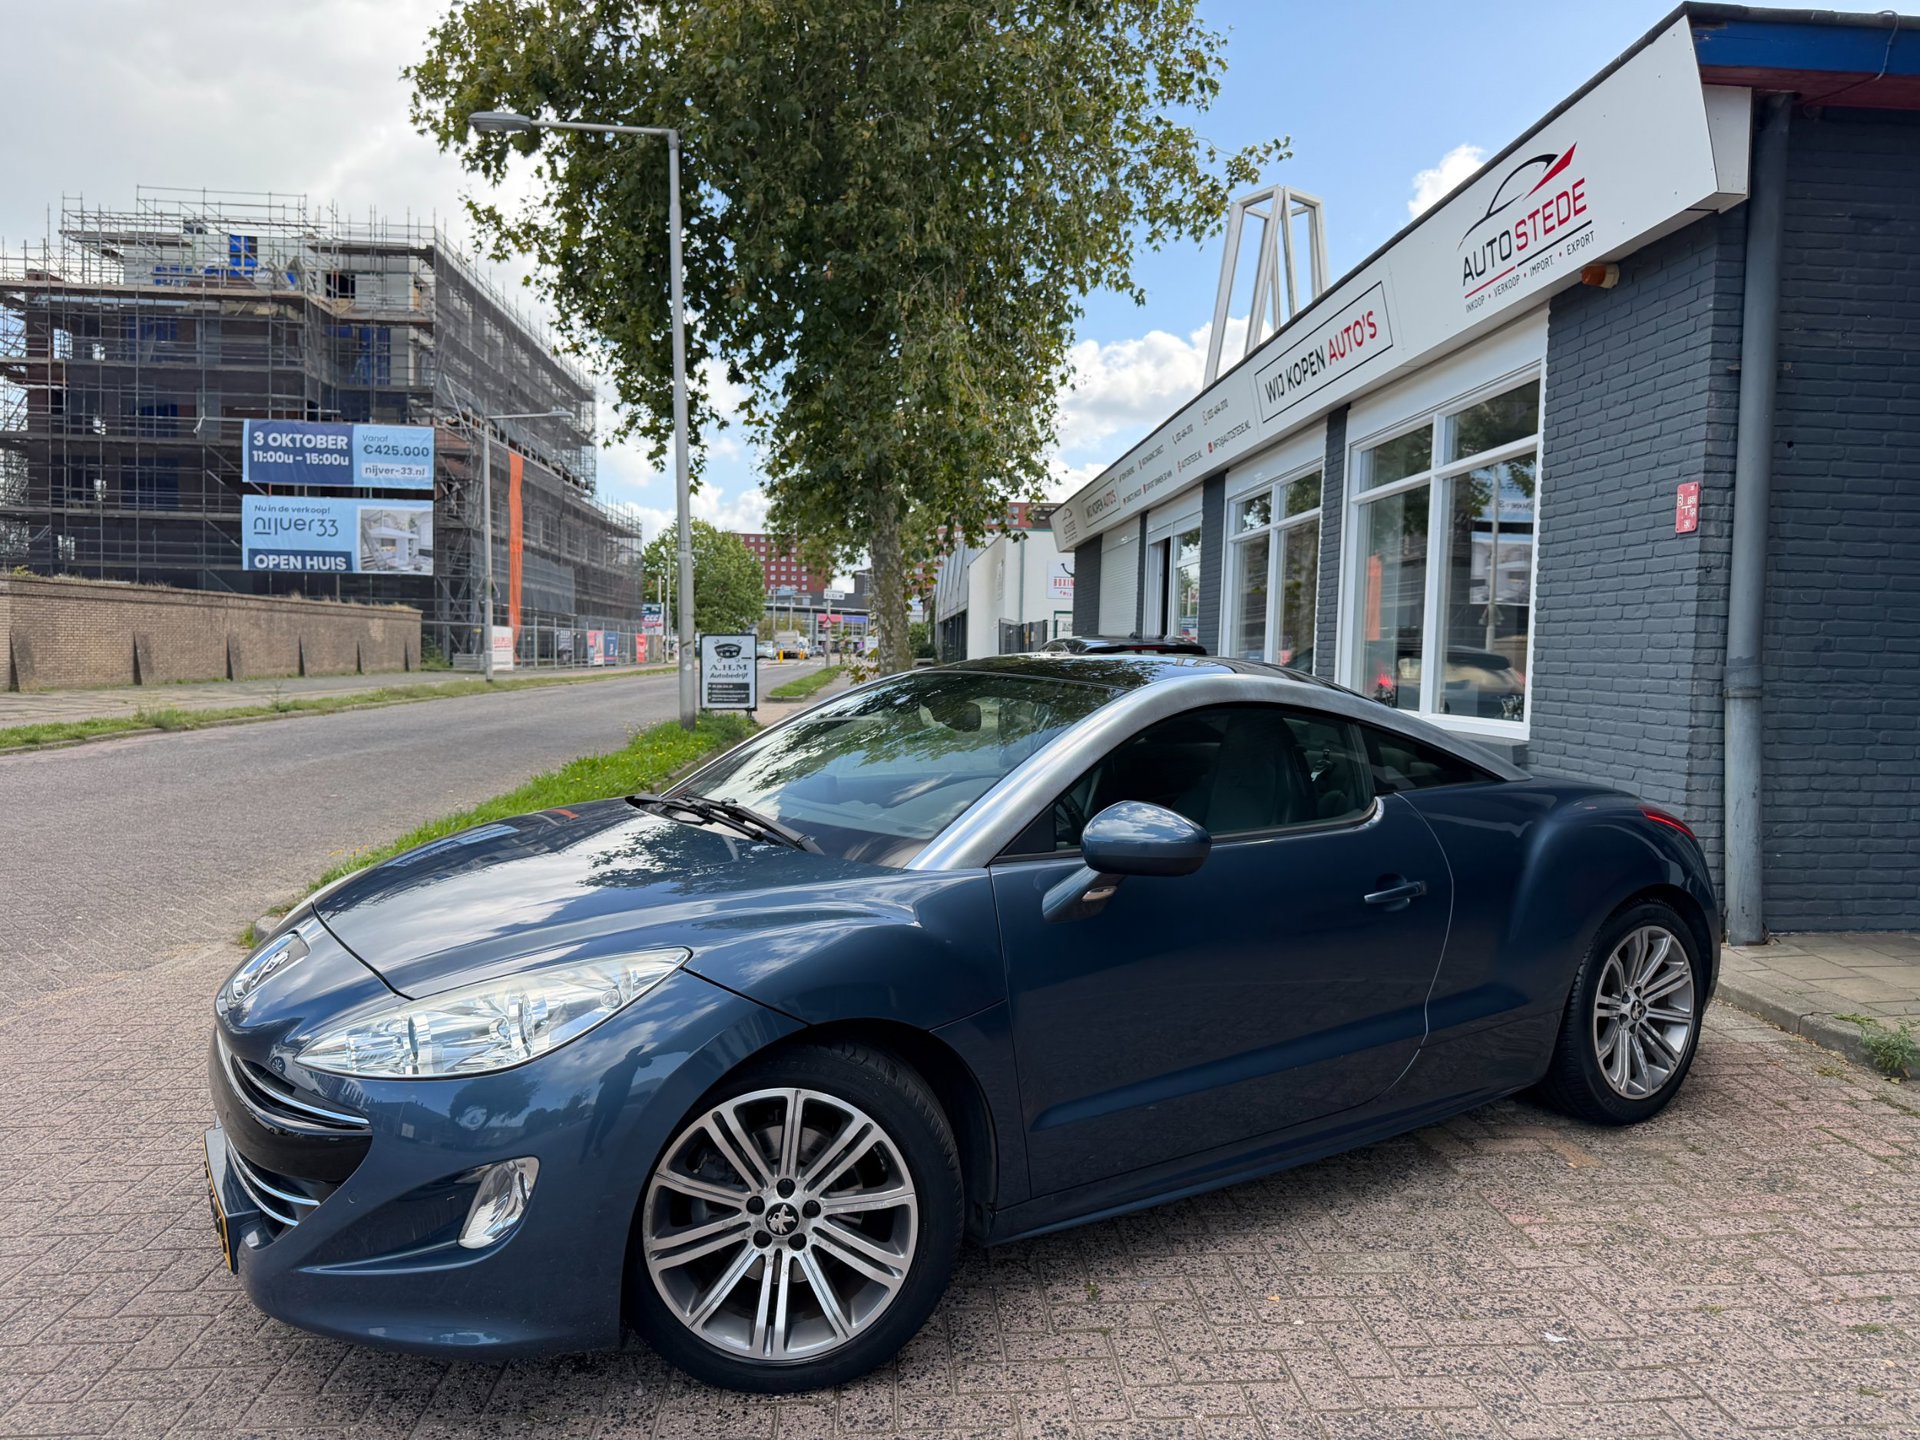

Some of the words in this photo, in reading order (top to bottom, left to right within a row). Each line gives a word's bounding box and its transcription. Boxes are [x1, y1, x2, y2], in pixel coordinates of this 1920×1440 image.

[1466, 295, 1485, 313] INKOOP
[1494, 275, 1520, 298] VERKOOP
[1529, 255, 1554, 277] IMPORT
[1566, 230, 1595, 256] EXPORT
[1264, 373, 1285, 403] WIJ
[1285, 345, 1326, 392] KOPEN
[1328, 310, 1377, 366] AUTO'S
[253, 432, 265, 447] 3
[268, 433, 349, 450] OKTOBER
[362, 434, 389, 443] Vanaf
[252, 450, 294, 464] 11:00u
[305, 452, 350, 467] 15:00u
[363, 444, 430, 458] €425.000
[364, 465, 426, 477] nijver-33.nl
[254, 504, 267, 513] Nu
[268, 505, 277, 513] in
[279, 505, 290, 513] de
[291, 506, 331, 515] verkoop!
[254, 554, 303, 570] OPEN
[305, 555, 347, 571] HUIS
[710, 672, 749, 680] Autobedrijf
